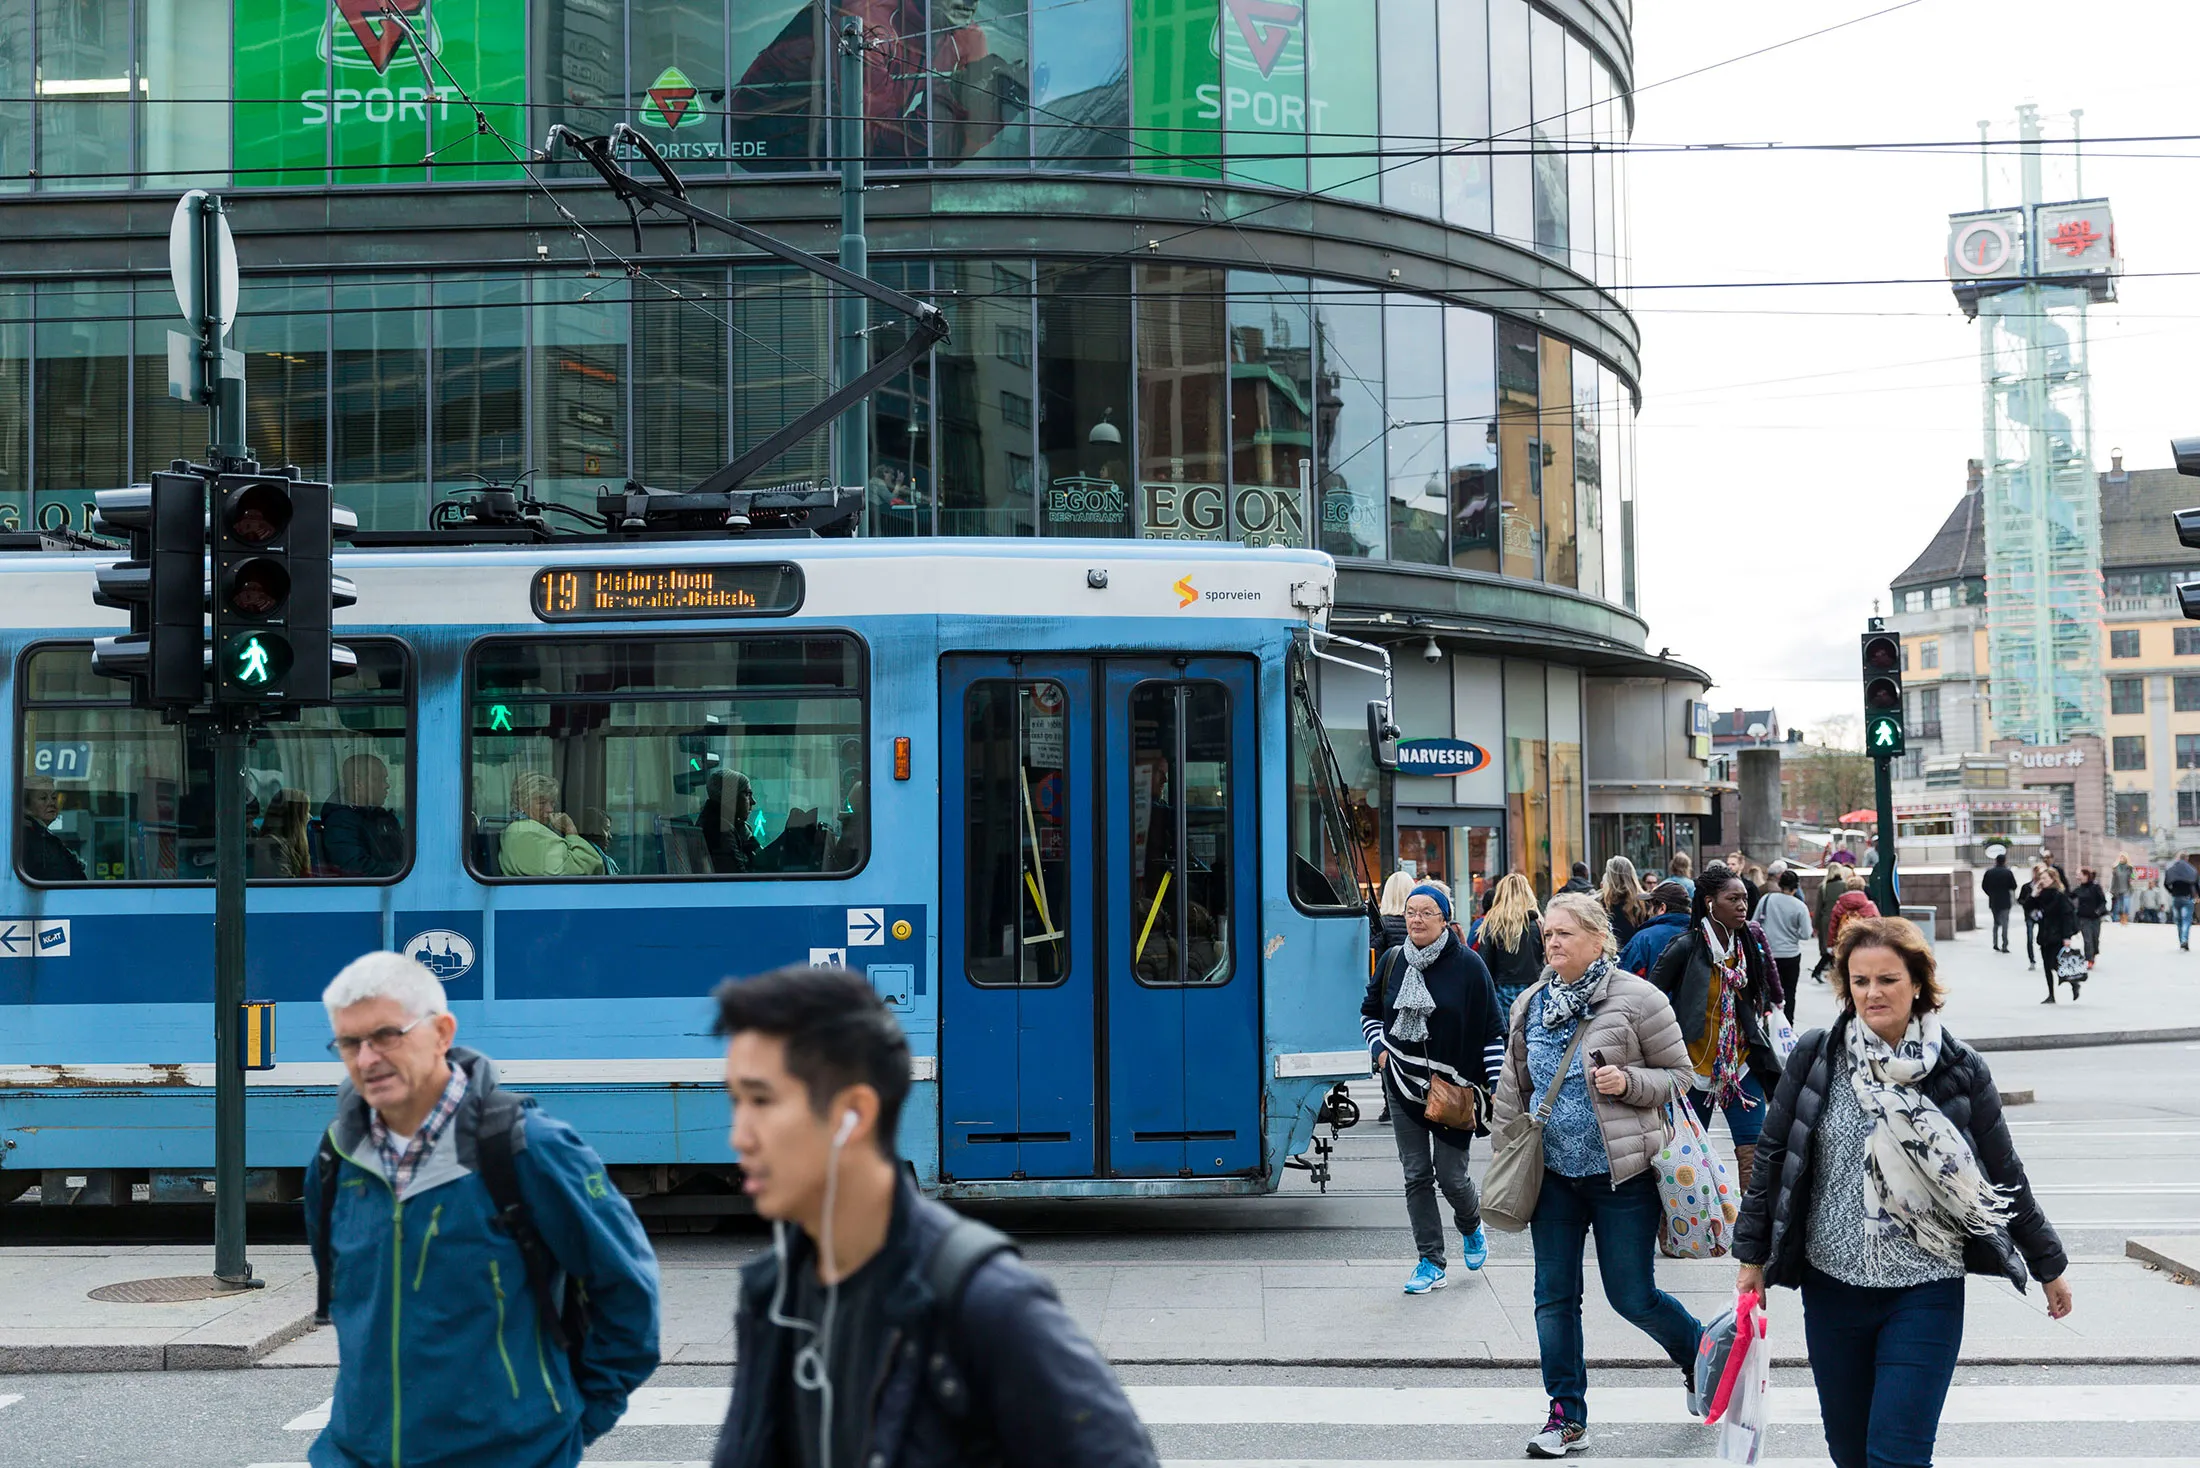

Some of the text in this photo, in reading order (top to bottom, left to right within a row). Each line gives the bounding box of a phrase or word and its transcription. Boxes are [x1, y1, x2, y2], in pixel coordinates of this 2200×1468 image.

[301, 85, 458, 124] SPORT
[1195, 84, 1328, 133] SPORT
[631, 141, 767, 158] SORTSGLEDE
[2058, 220, 2091, 236] NSB
[1049, 490, 1124, 512] EGON
[1142, 484, 1303, 533] EGON
[1049, 512, 1125, 523] RESTAURANT
[1323, 501, 1378, 525] EGON
[541, 572, 578, 611] 19
[1205, 589, 1261, 602] sporveien
[1399, 748, 1474, 765] NARVESEN
